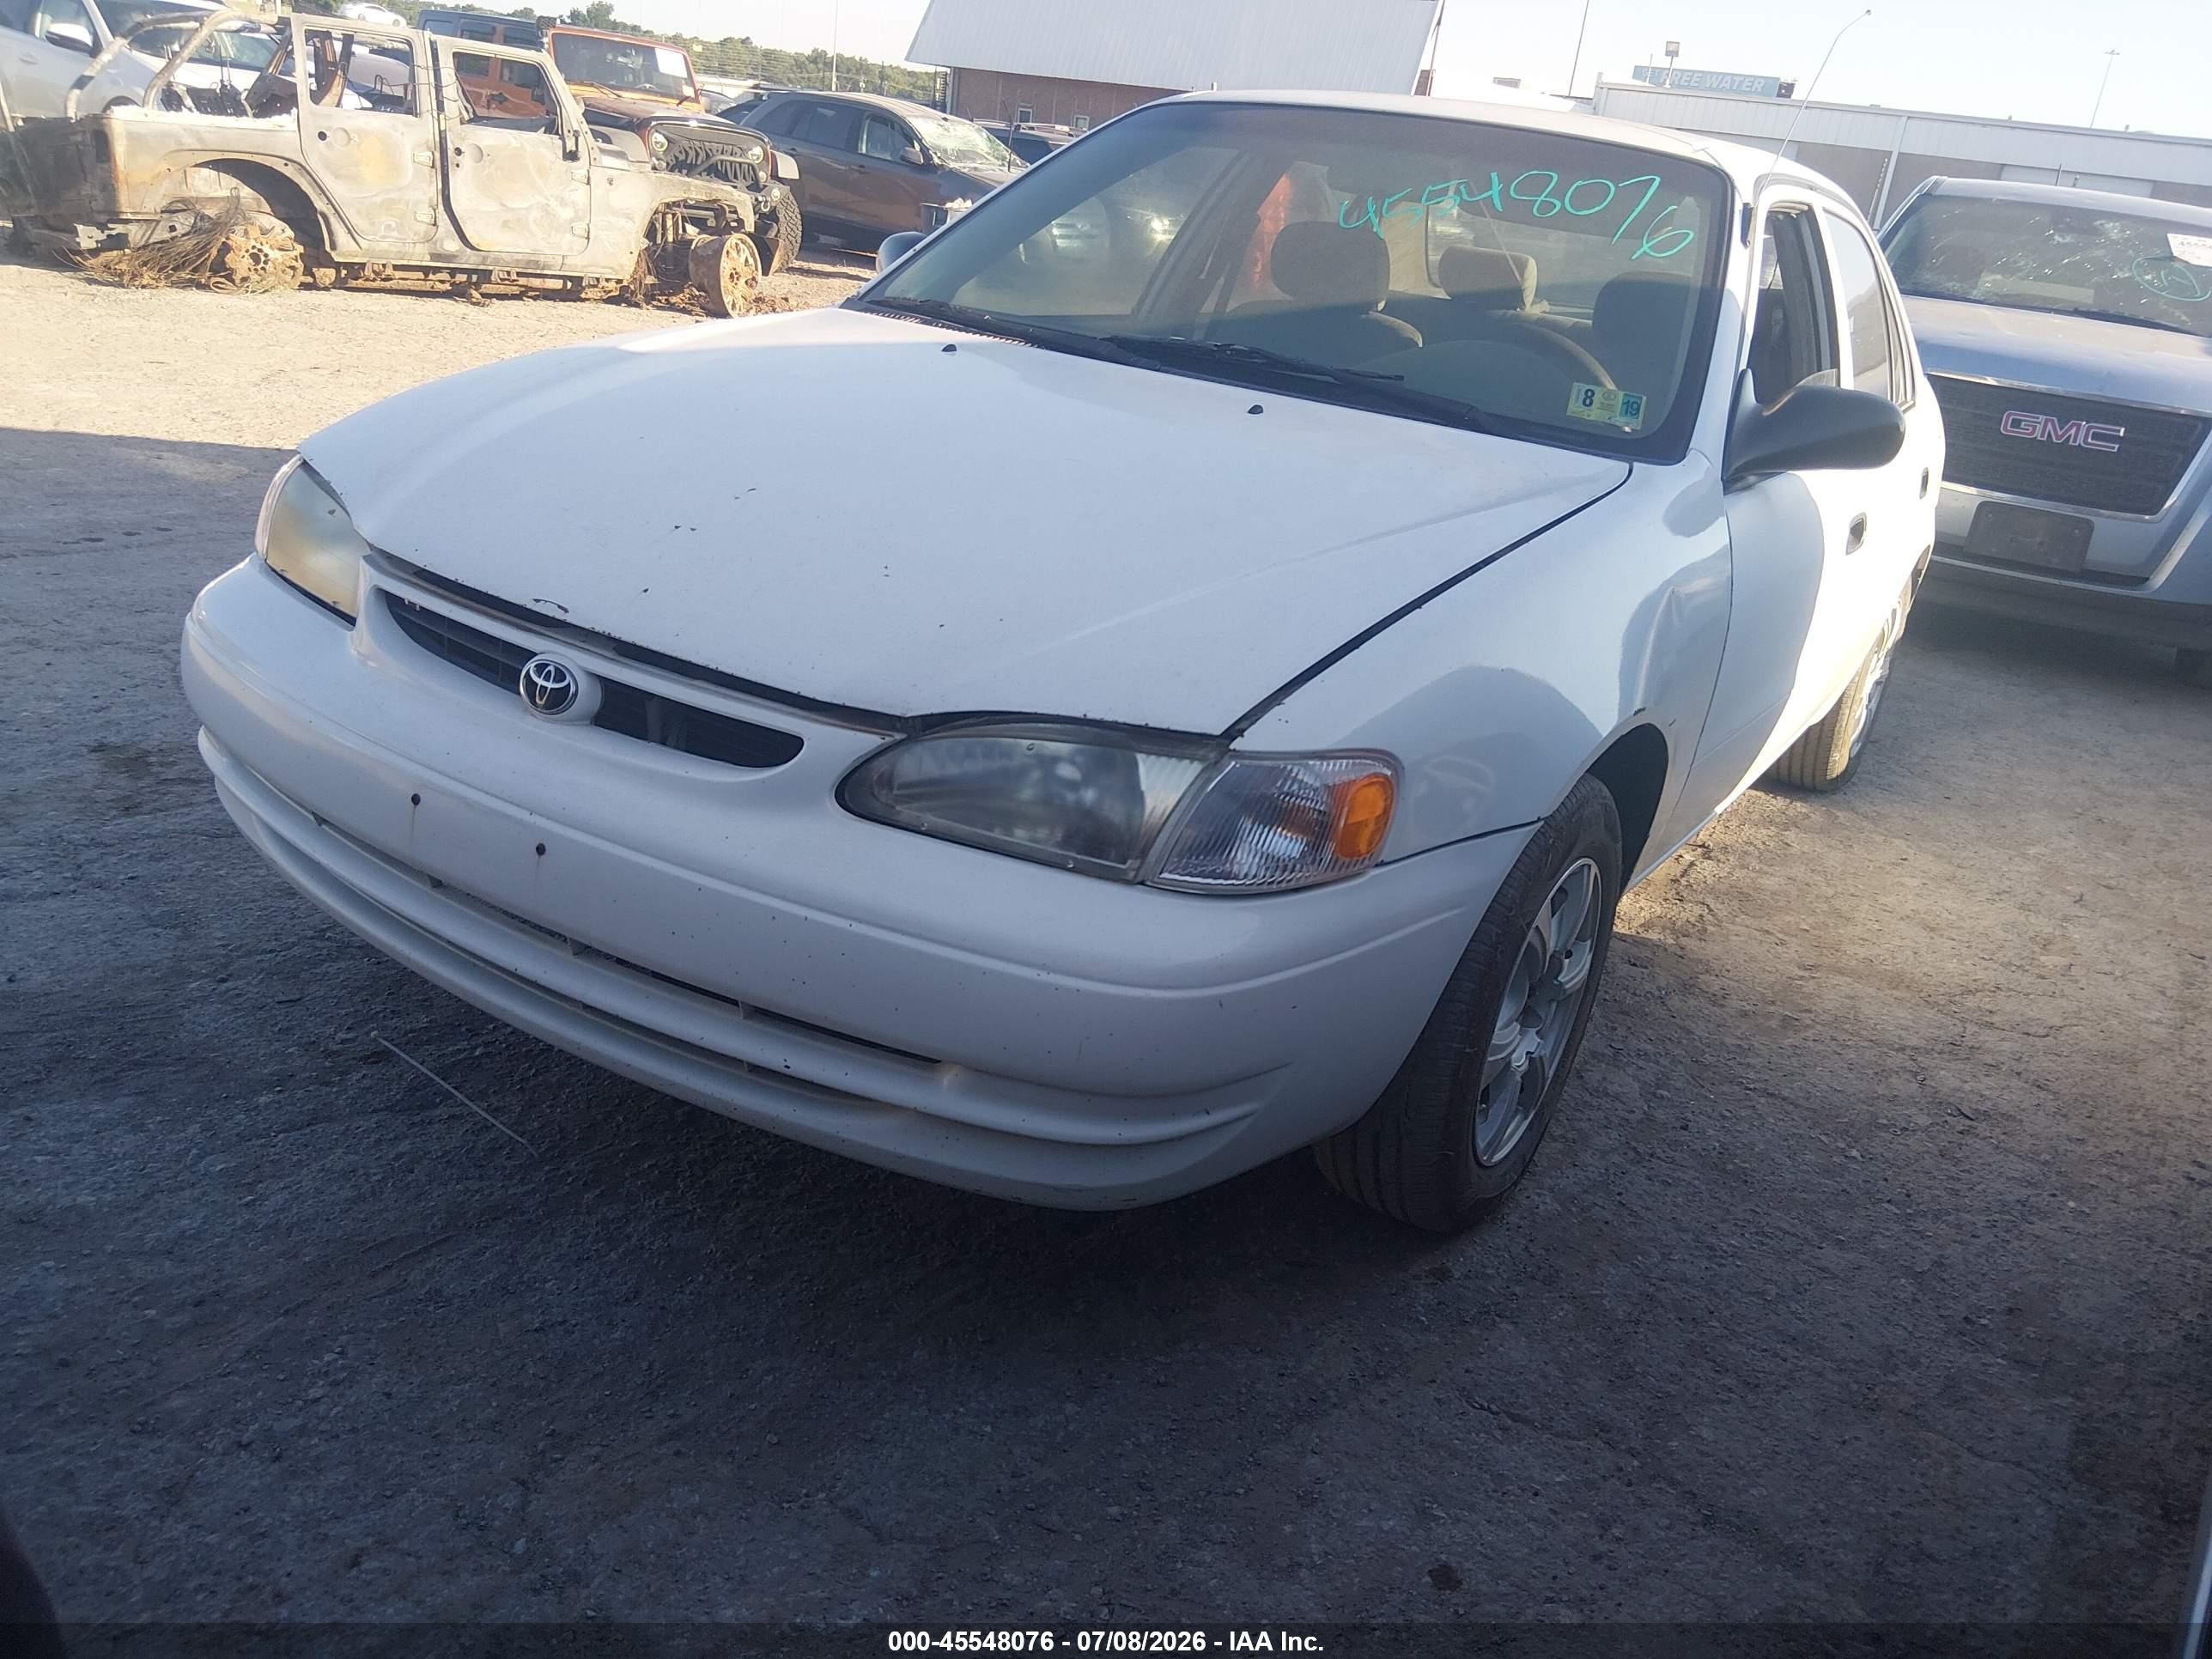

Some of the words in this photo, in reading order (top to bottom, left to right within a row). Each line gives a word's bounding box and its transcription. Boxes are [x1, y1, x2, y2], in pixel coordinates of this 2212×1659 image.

[1659, 70, 1702, 87] FREE
[1705, 73, 1765, 93] WATER
[1582, 388, 1595, 408] 8
[1621, 399, 1640, 416] 19
[2000, 410, 2126, 453] GMC
